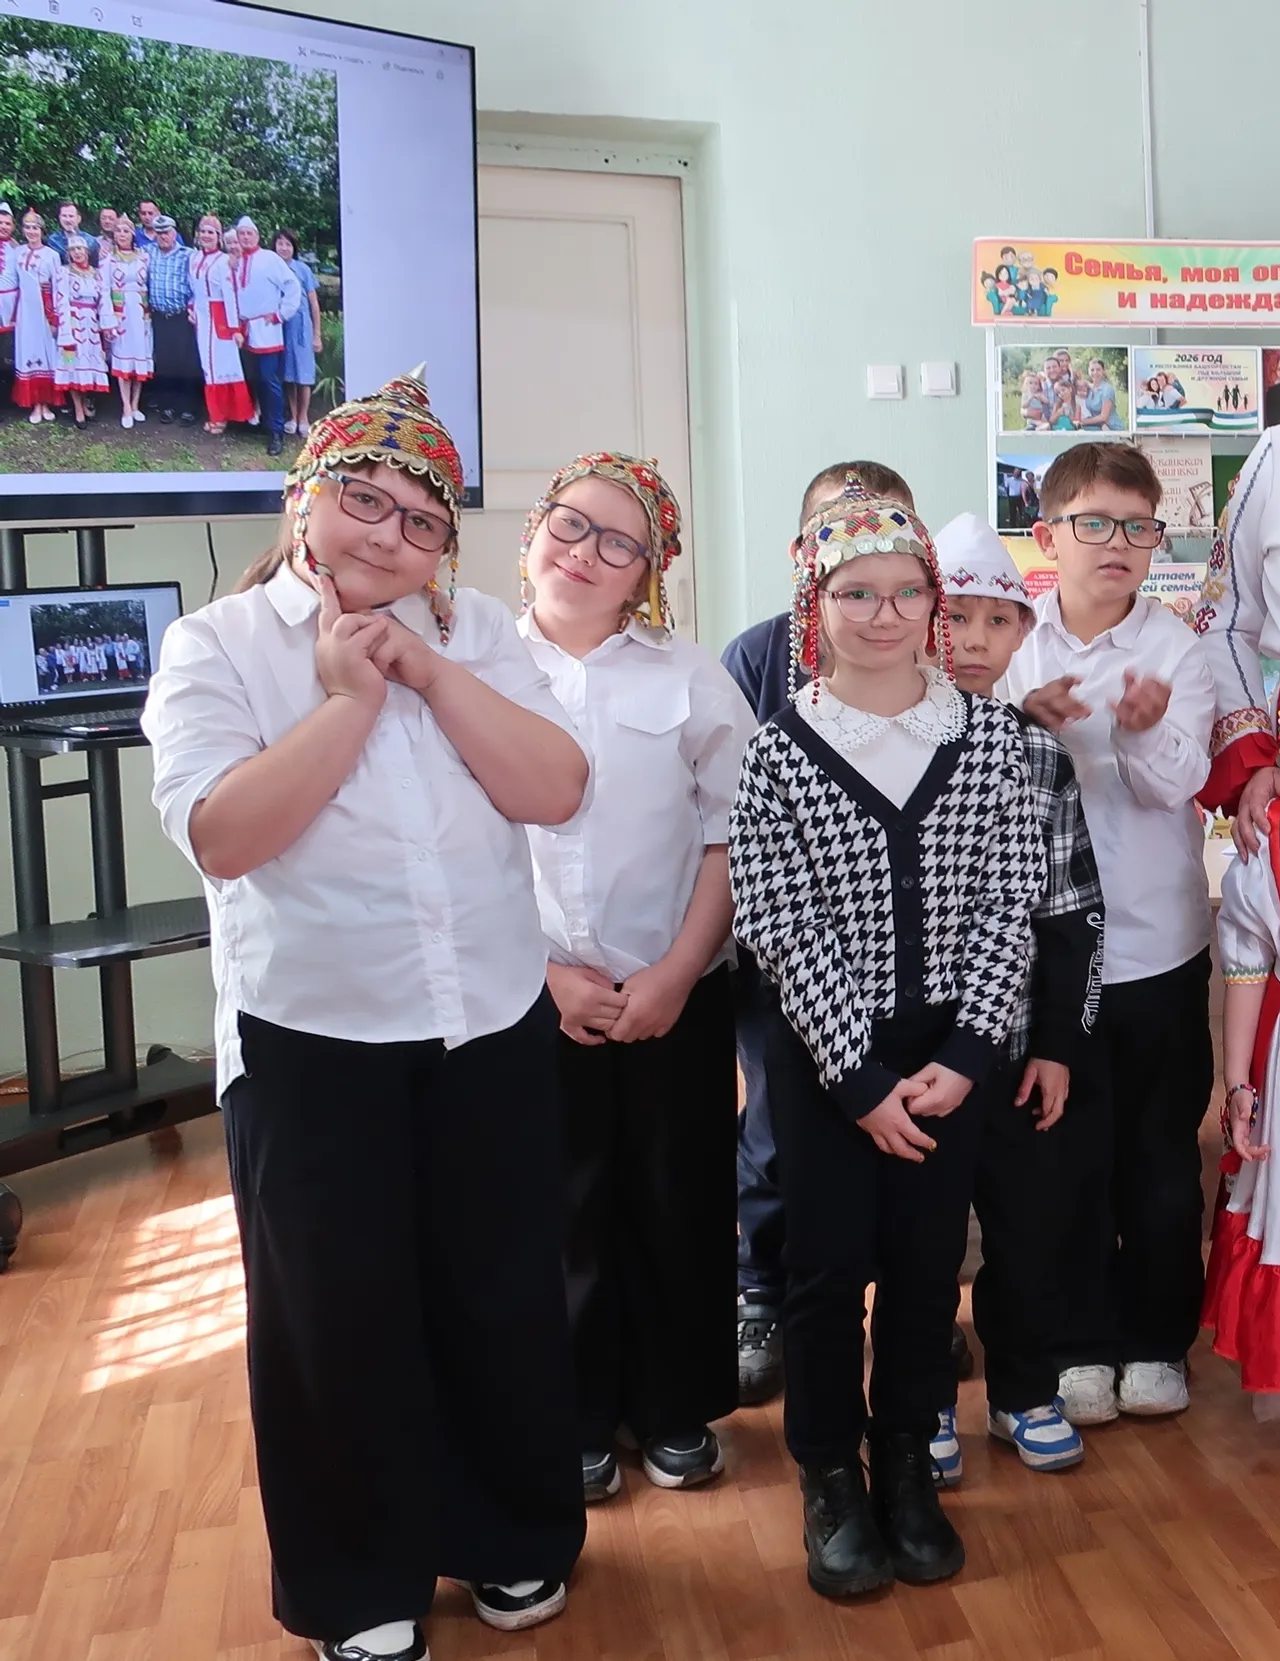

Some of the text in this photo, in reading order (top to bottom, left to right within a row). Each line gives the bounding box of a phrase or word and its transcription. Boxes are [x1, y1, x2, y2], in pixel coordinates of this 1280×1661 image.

[1064, 252, 1168, 283] Семья,
[1181, 266, 1240, 283] моя
[1174, 353, 1223, 364] 2026 ГОД
[1157, 467, 1199, 476] ышивка
[1137, 582, 1157, 592] сей
